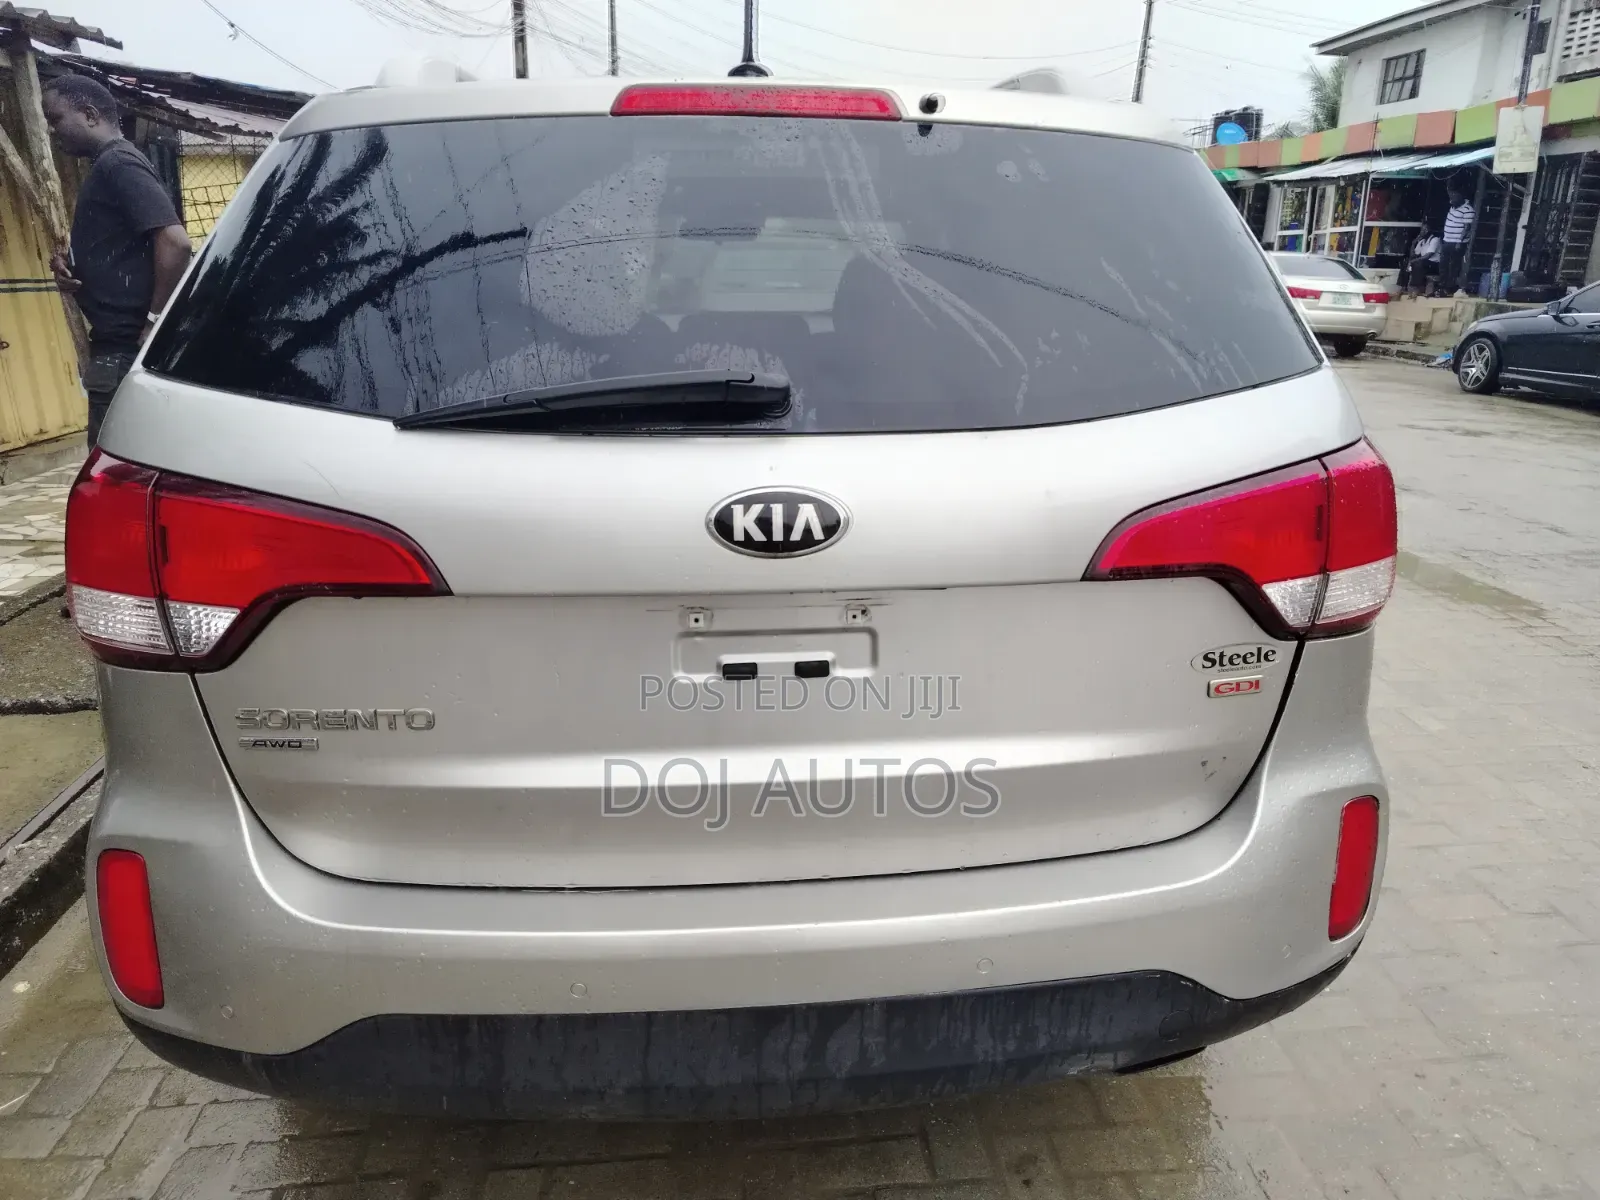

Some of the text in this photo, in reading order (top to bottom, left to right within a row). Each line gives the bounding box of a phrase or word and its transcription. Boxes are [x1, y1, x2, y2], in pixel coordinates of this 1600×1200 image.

[731, 503, 825, 542] KIA
[1201, 646, 1277, 669] Steele
[1213, 679, 1260, 695] GDI
[234, 707, 436, 731] SORENTO
[251, 739, 303, 749] AWD
